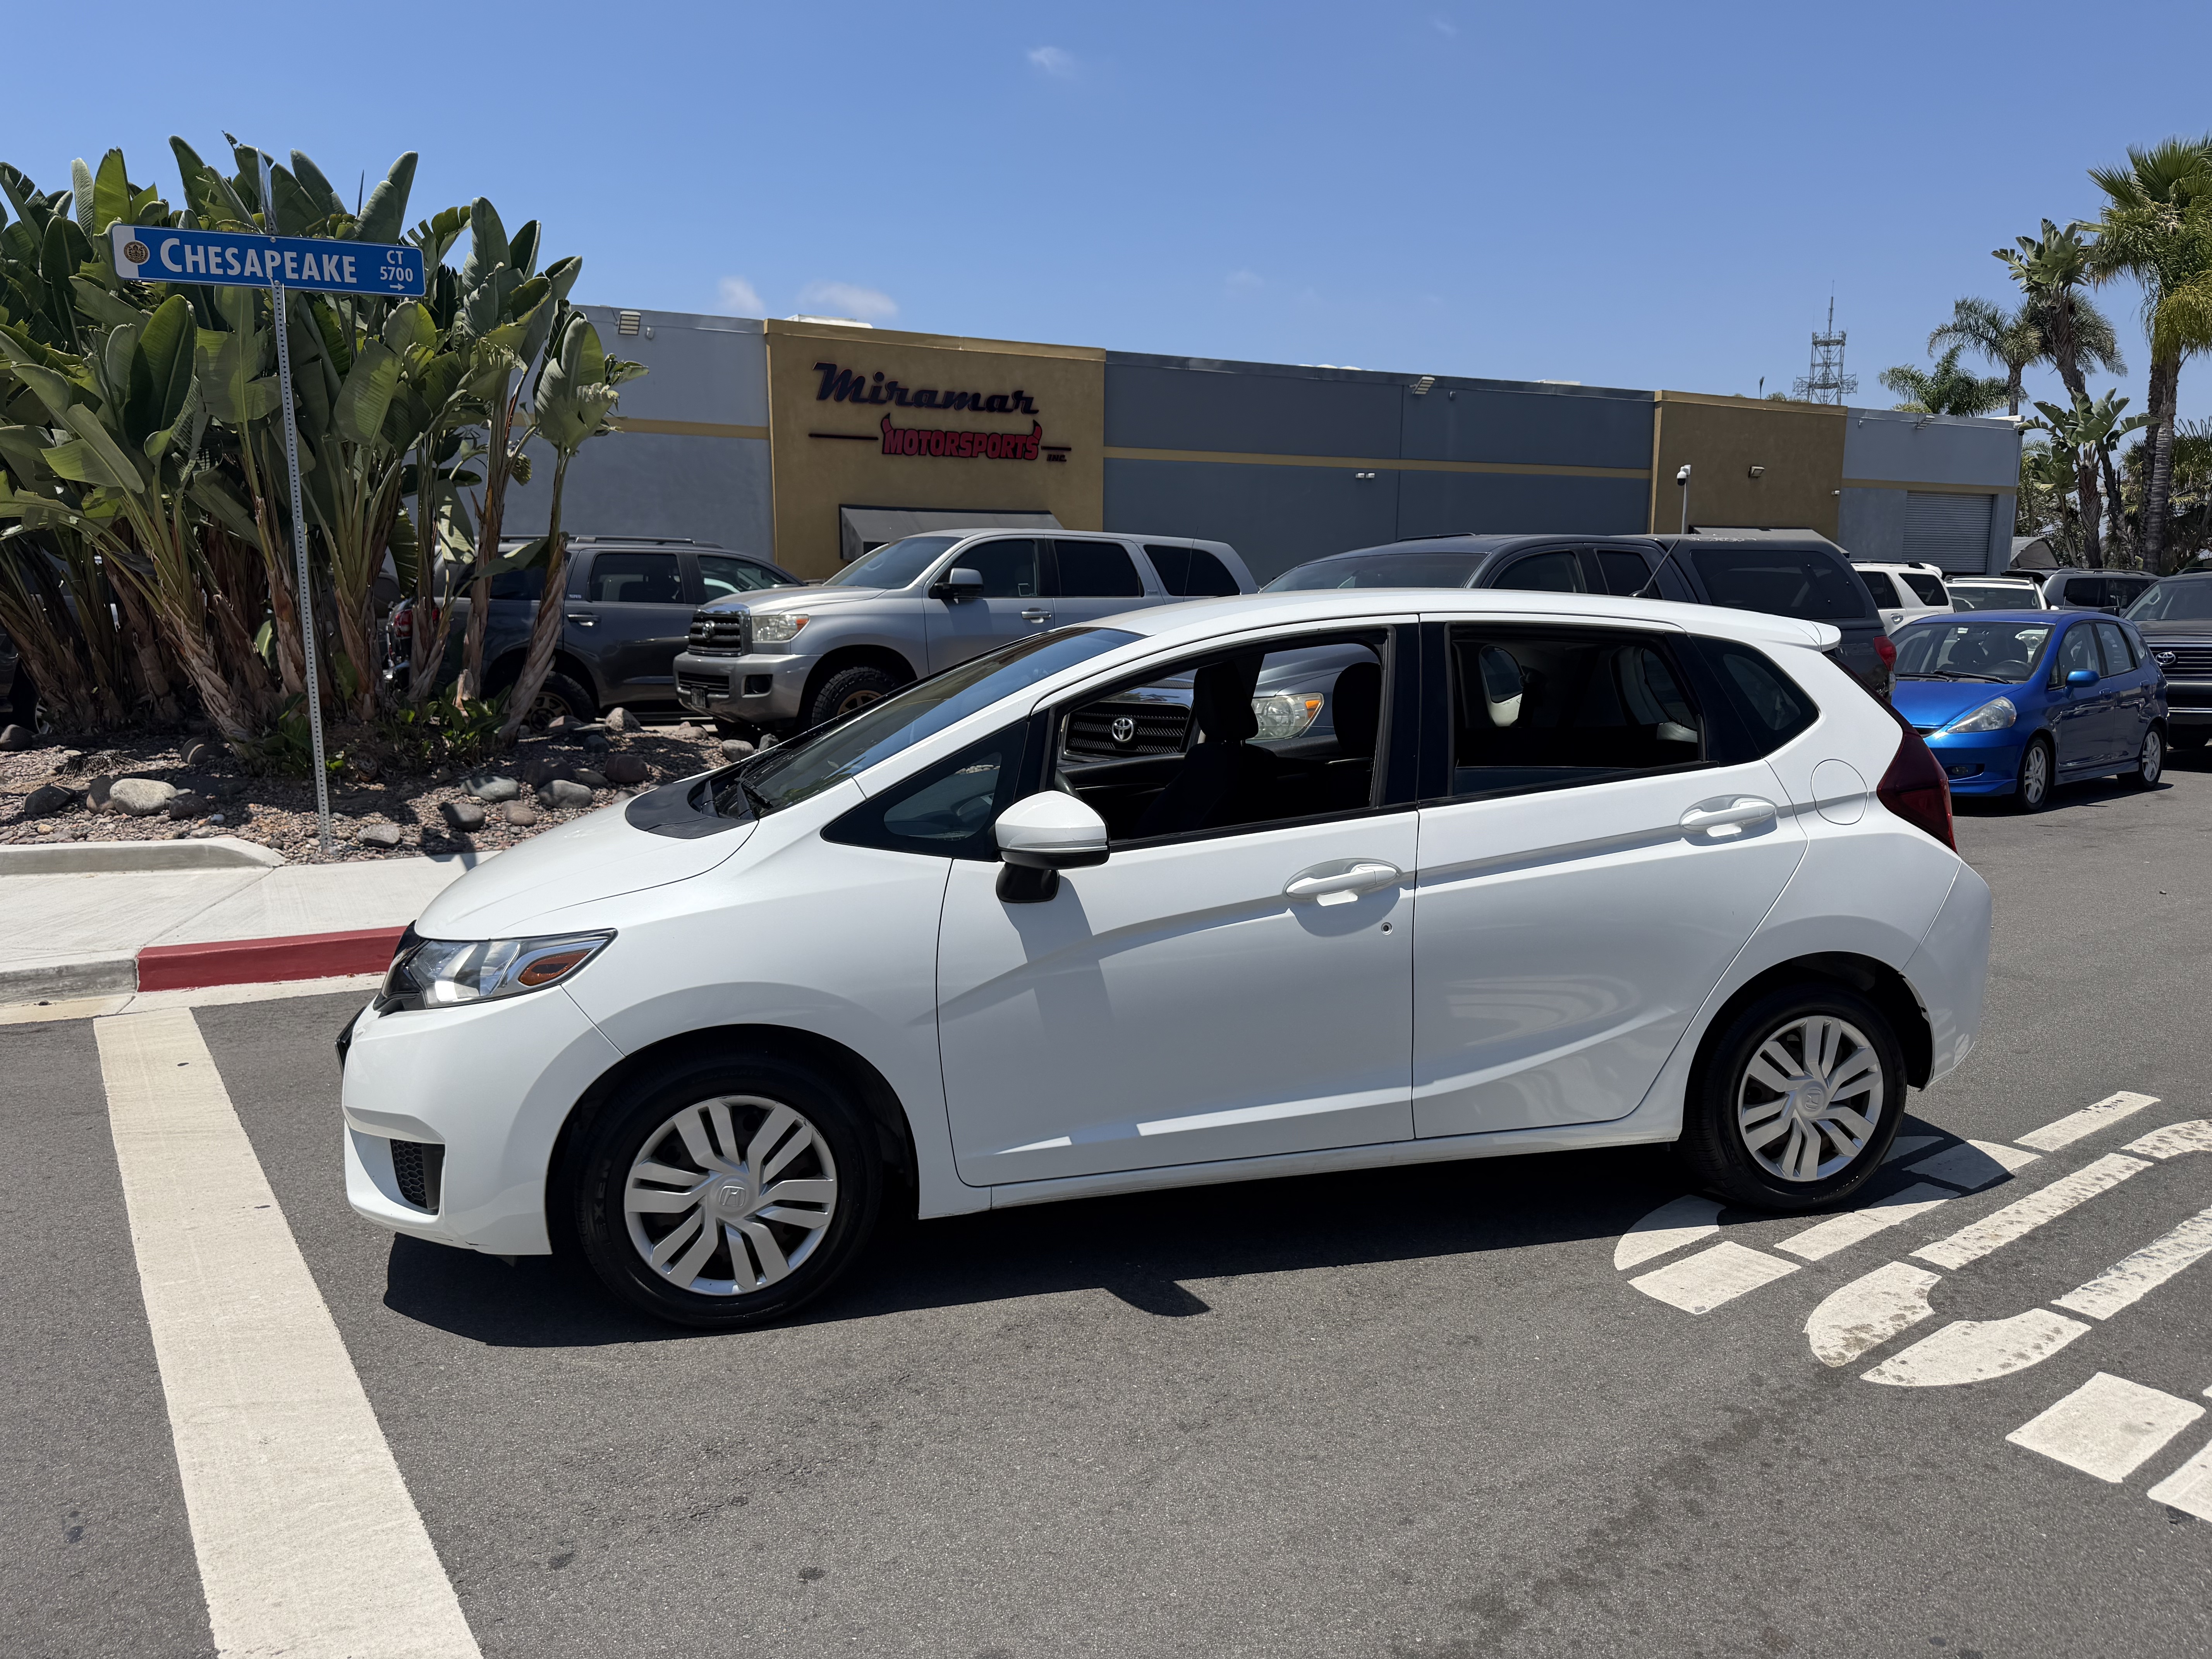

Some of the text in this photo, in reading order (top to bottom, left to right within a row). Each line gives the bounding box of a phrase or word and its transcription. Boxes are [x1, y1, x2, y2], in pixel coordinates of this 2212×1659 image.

[160, 238, 357, 283] CHESAPEAKE
[380, 266, 413, 282] 5700
[386, 250, 404, 264] CT
[813, 362, 1039, 414] Miramar
[881, 425, 1041, 461] MOTORSPORTS
[594, 1158, 613, 1249] EXEN
